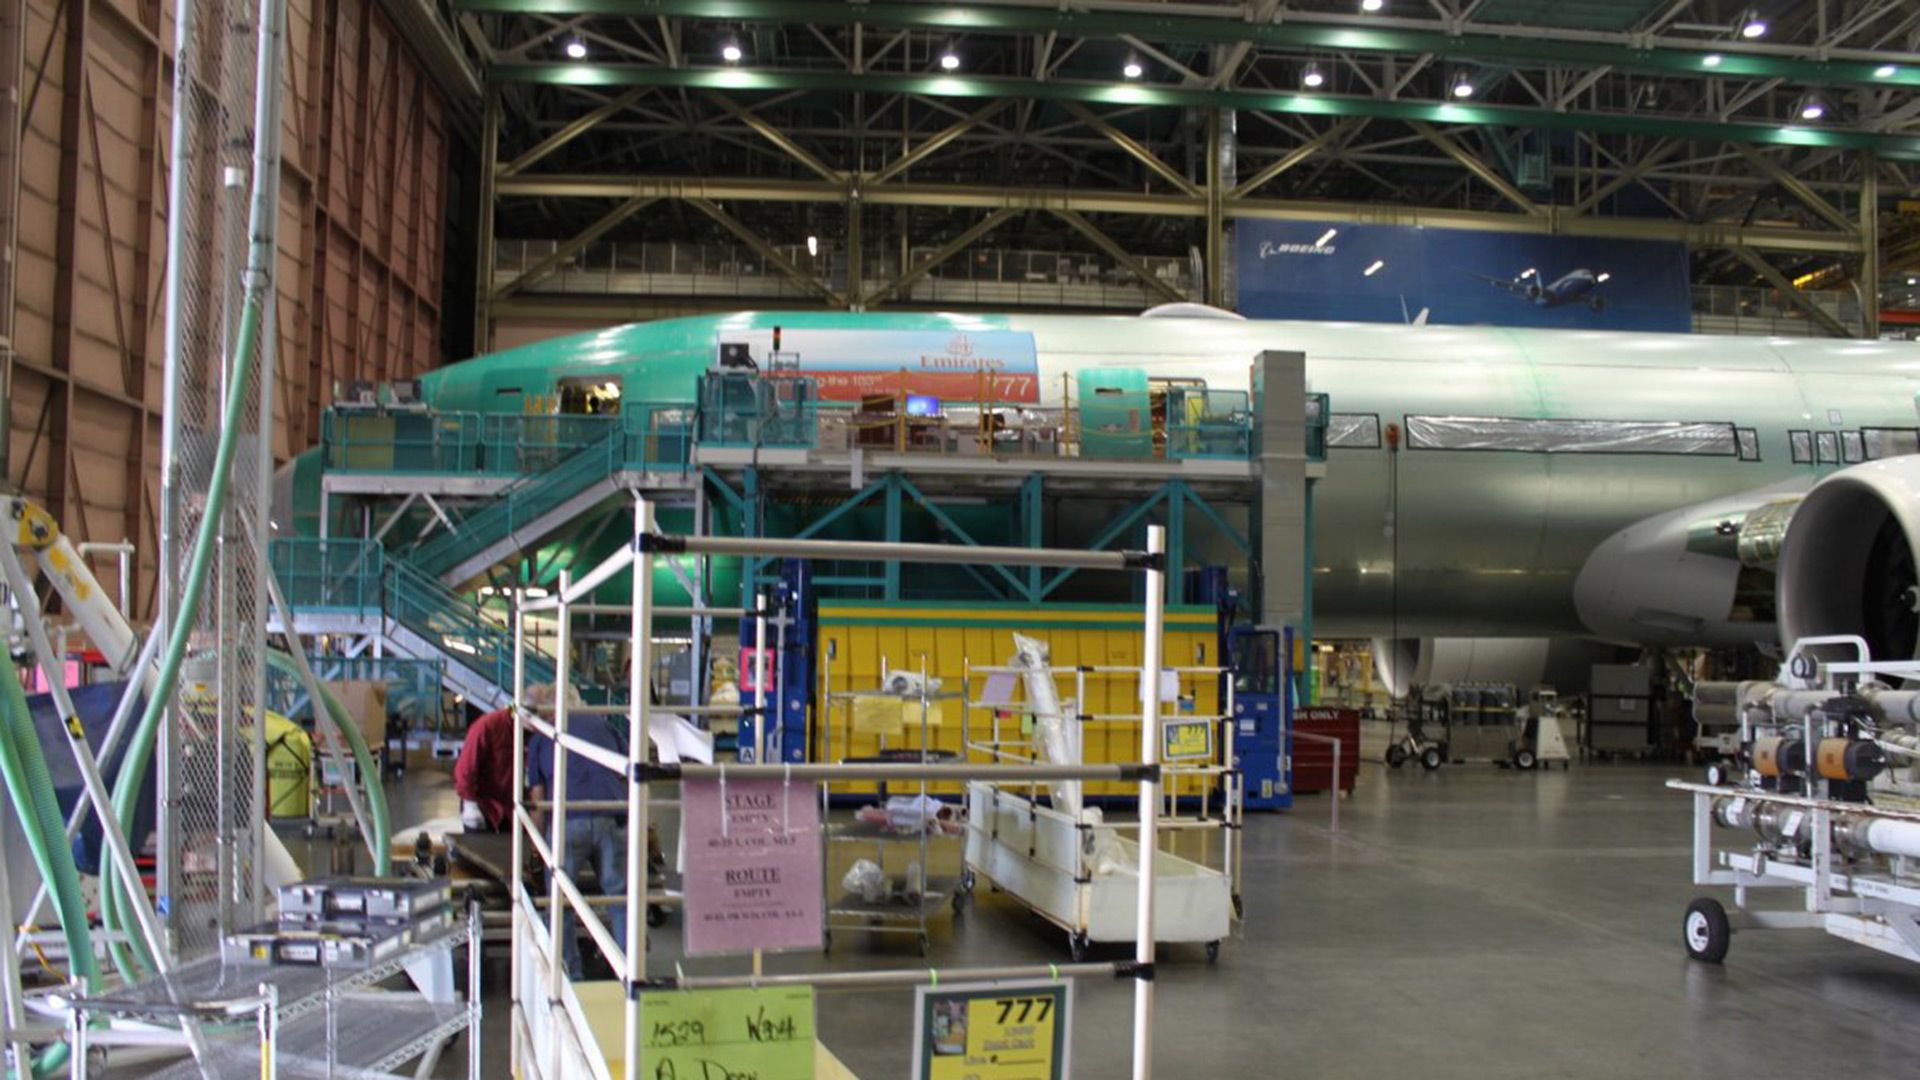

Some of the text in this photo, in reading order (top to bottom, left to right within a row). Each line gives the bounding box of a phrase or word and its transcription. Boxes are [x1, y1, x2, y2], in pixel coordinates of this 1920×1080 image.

[920, 354, 1006, 369] Emirates
[1310, 709, 1340, 721] ONLY
[724, 793, 777, 809] STAGE
[730, 814, 770, 824] EMPTY
[725, 867, 782, 884] ROUTE
[733, 887, 772, 898] EMPTY
[996, 997, 1053, 1025] 777
